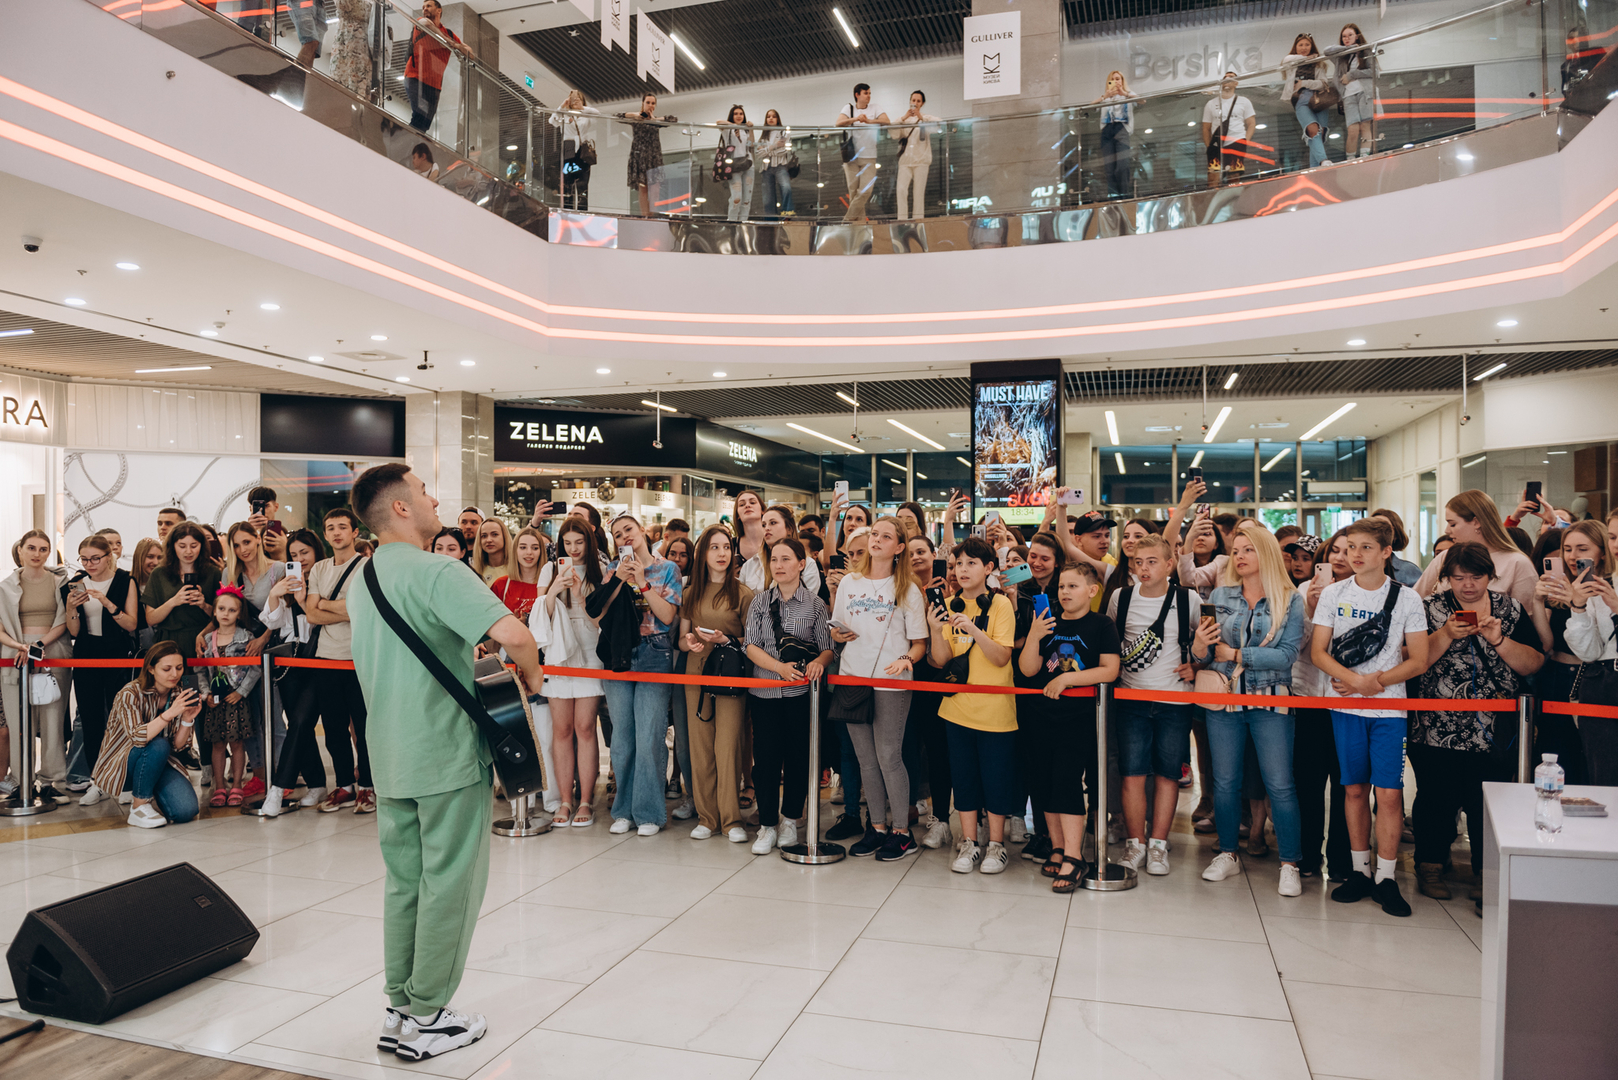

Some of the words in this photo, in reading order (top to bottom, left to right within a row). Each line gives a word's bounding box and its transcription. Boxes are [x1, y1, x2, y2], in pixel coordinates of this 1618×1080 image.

[971, 31, 1014, 43] GULLIVER
[1130, 42, 1263, 81] Bershka
[980, 386, 1014, 402] MUST
[1016, 384, 1049, 401] HAVE
[2, 396, 49, 428] RA
[509, 421, 604, 443] ZELENA
[728, 441, 758, 463] ZELENA
[572, 491, 597, 499] ZELE
[1010, 508, 1035, 516] 18:34
[1337, 606, 1378, 620] CREAT
